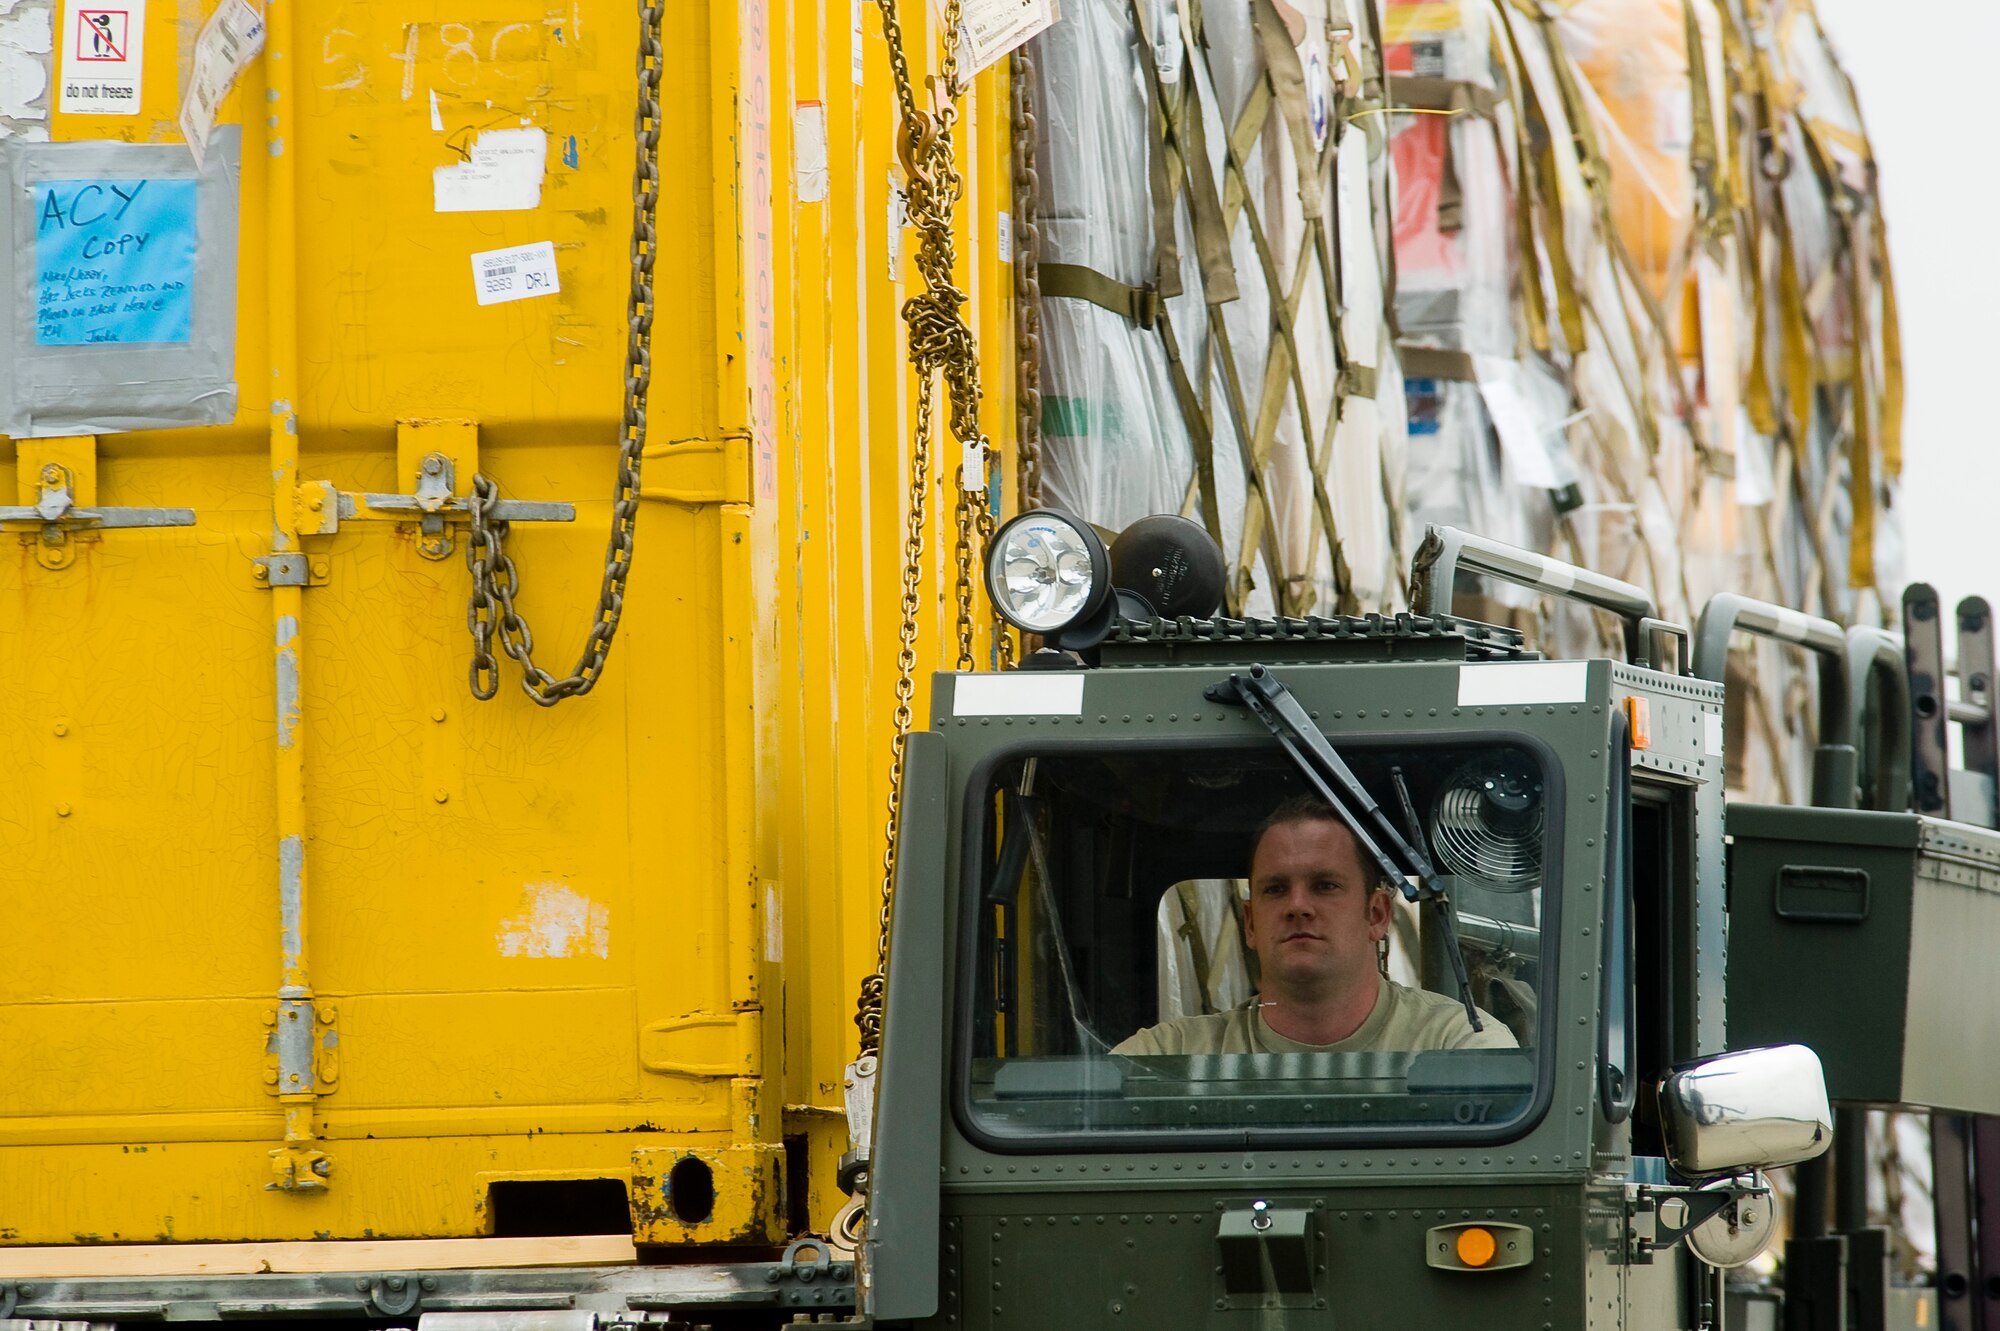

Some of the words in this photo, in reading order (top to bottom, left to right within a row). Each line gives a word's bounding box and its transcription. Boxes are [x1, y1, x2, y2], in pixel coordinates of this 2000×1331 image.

[66, 82, 80, 98] do
[82, 83, 99, 98] not
[101, 83, 134, 99] freeze
[39, 179, 148, 230] ACY
[1454, 1098, 1494, 1124] 07
